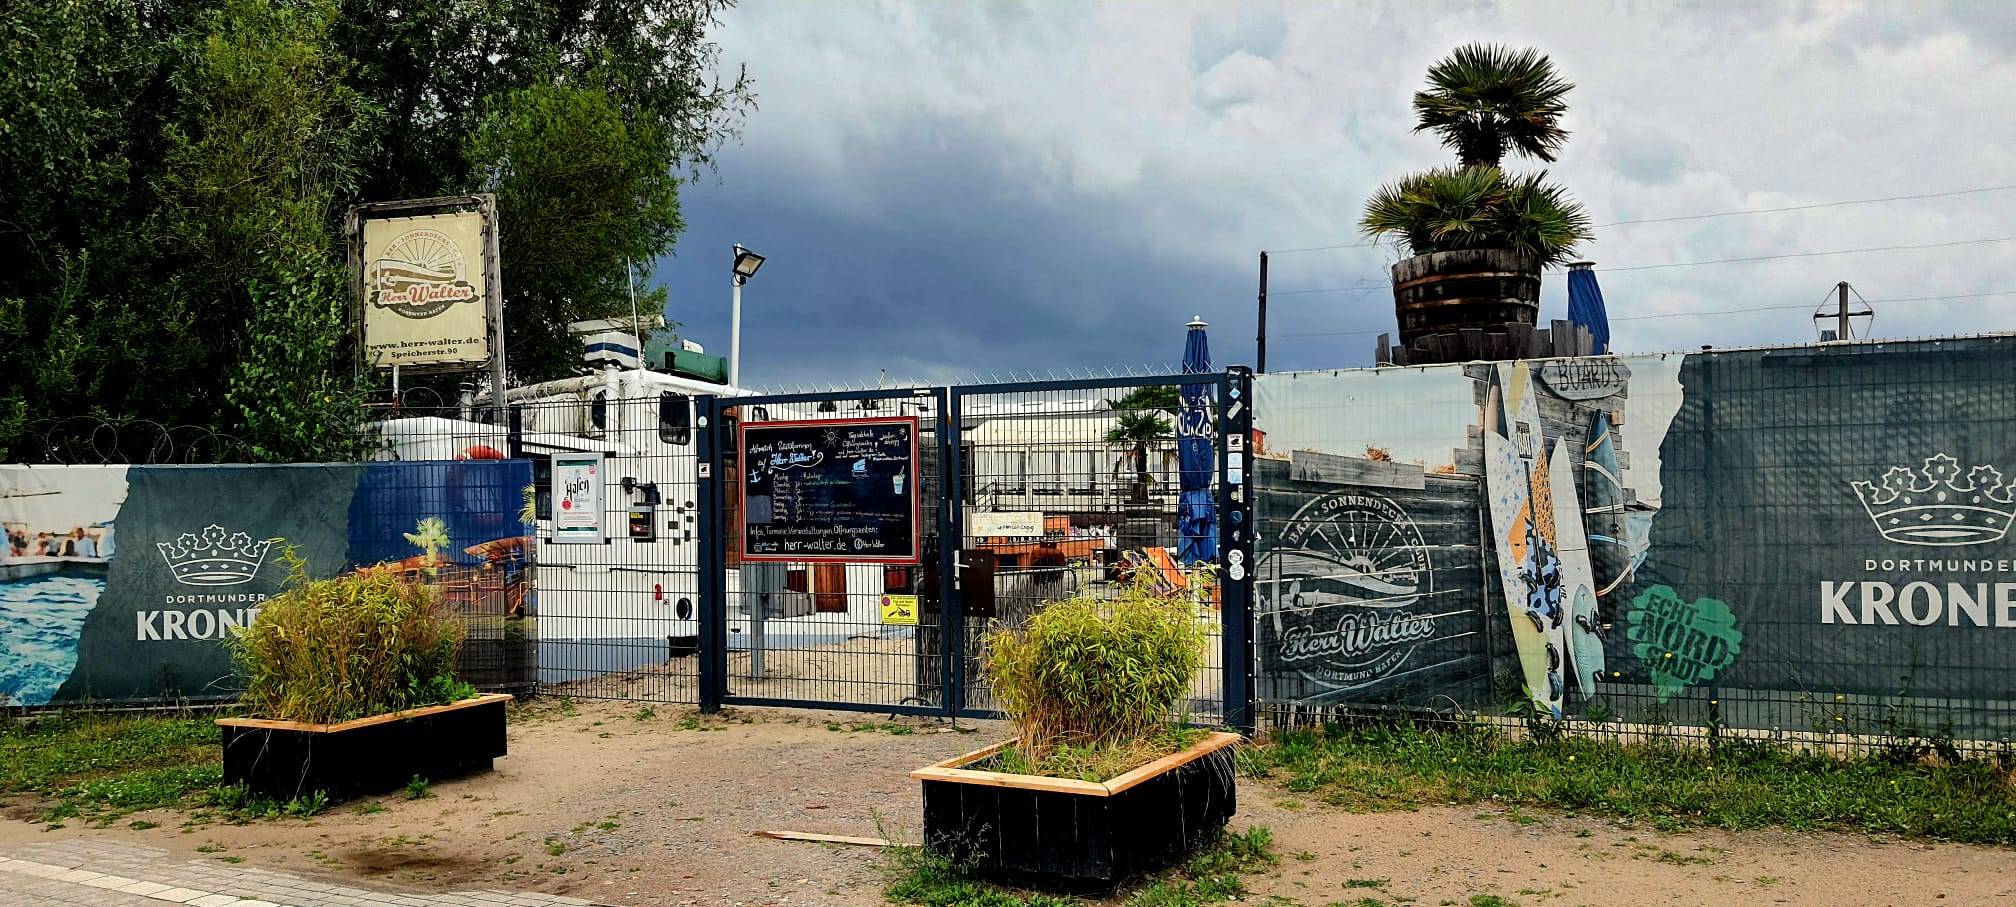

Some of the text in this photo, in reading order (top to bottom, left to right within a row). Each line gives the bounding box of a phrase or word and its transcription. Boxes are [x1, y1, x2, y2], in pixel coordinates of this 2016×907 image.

[380, 286, 471, 303] Herr Walter
[370, 337, 480, 351] www.herr-walter.de
[1557, 359, 1620, 391] BOARDS
[784, 538, 847, 551] herr-walter.de
[1865, 559, 2016, 573] DORTMUNDE
[166, 593, 266, 605] DORTMUNDER
[1646, 594, 1699, 626] ECHT
[1286, 614, 1433, 656] Herr Walter
[1636, 610, 1730, 666] NORD
[1315, 649, 1402, 681] DORTMUND HAFEN
